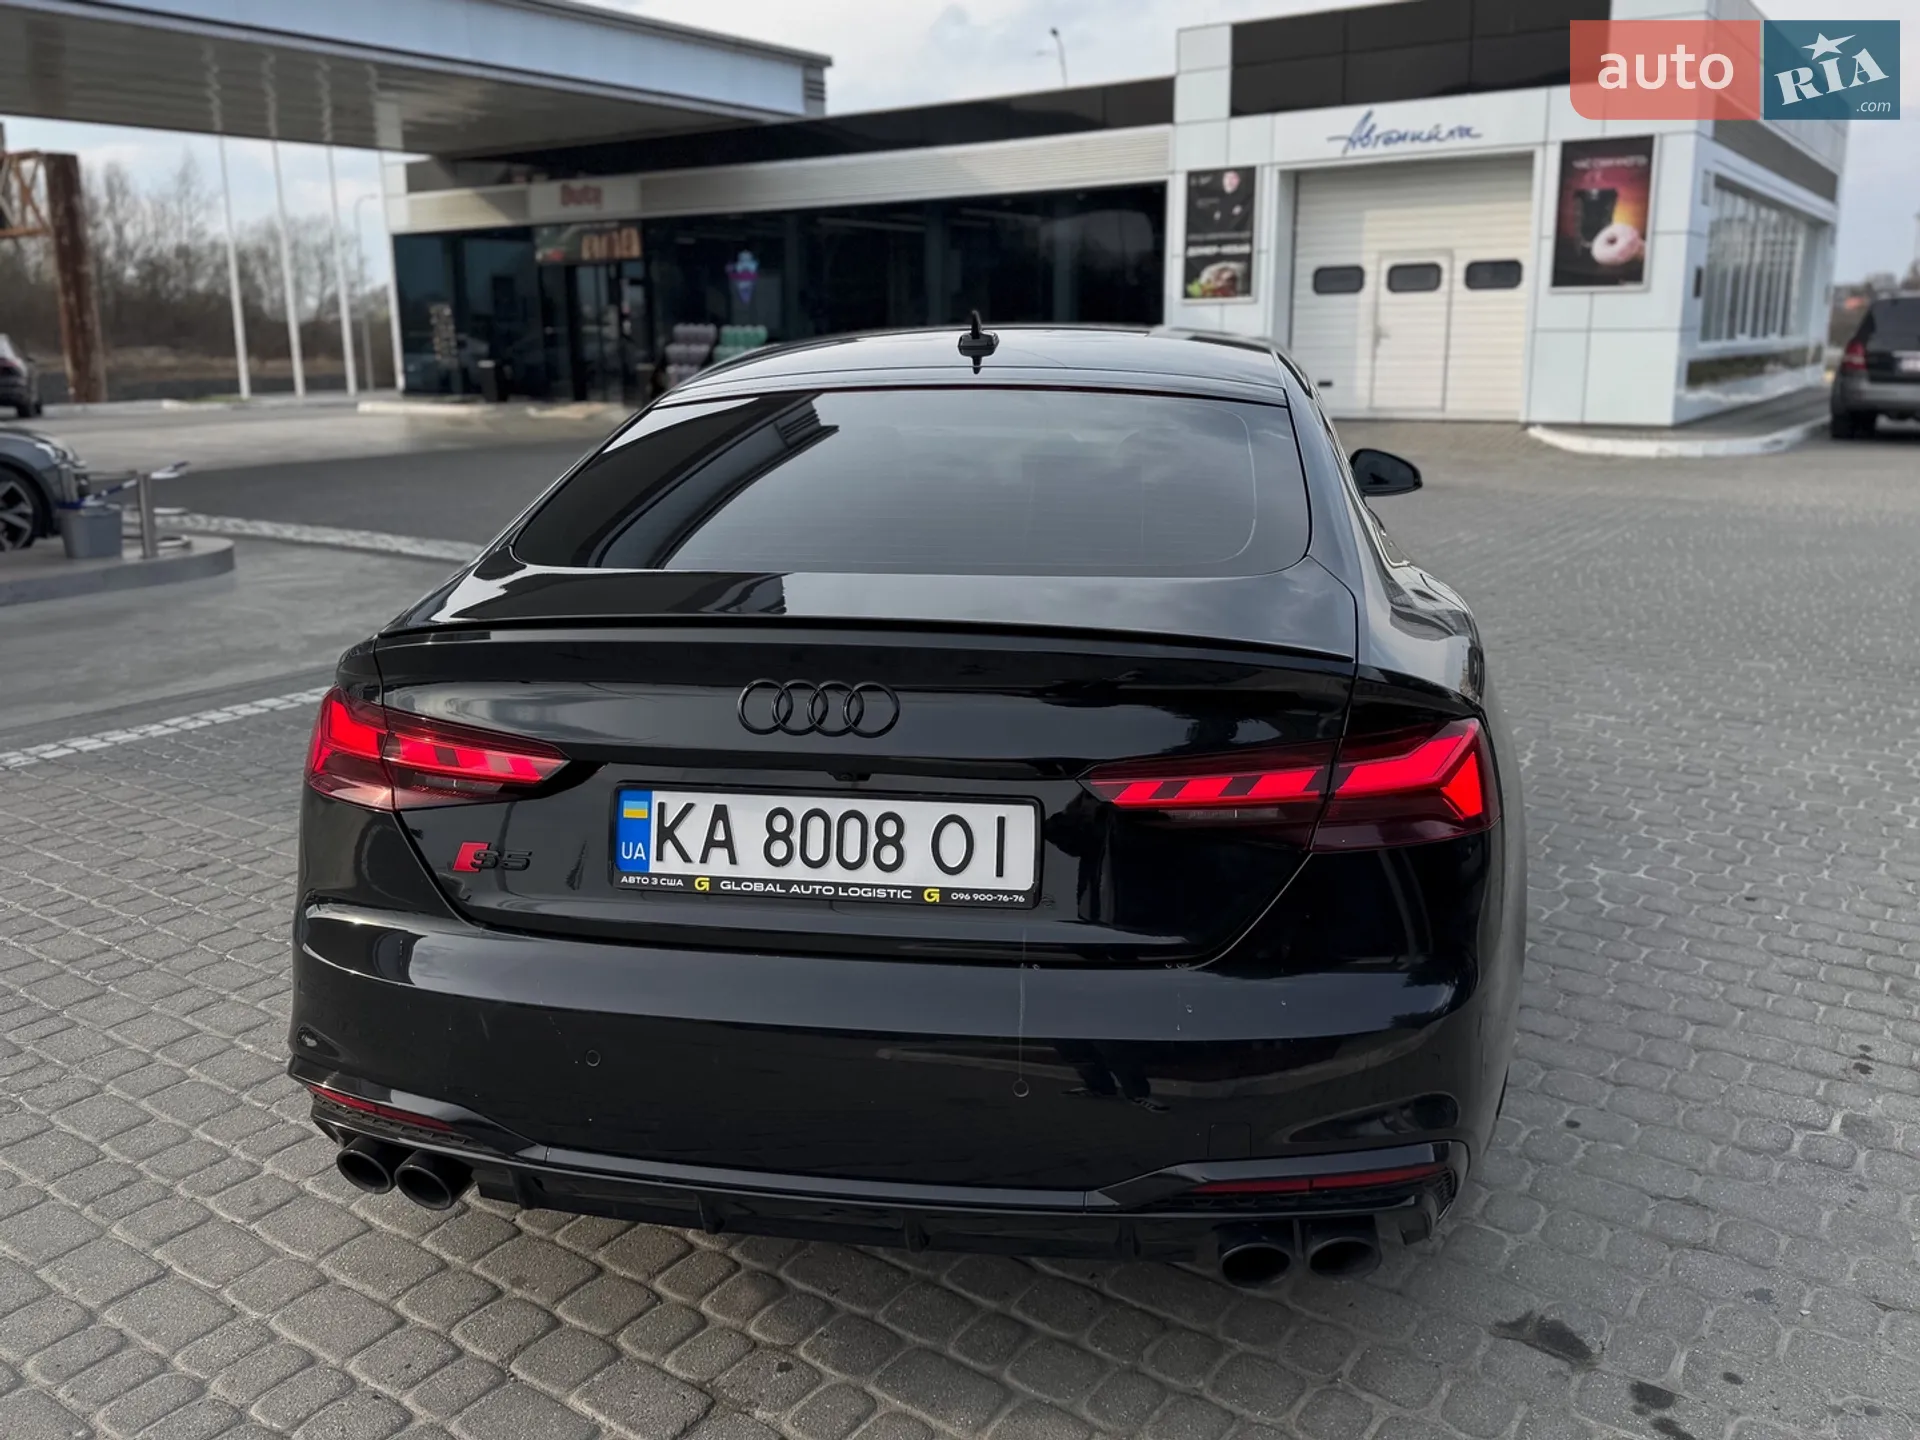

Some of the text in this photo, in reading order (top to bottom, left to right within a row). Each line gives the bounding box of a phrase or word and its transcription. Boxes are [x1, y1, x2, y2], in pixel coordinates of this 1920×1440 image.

[763, 805, 906, 873] 8008
[470, 848, 533, 872] S5
[620, 841, 647, 861] UA
[620, 875, 650, 886] АВТО
[659, 878, 684, 888] США
[719, 880, 913, 900] GLOBAL AUTO LOGISTIC
[950, 892, 1026, 904] 096 900-76-76
